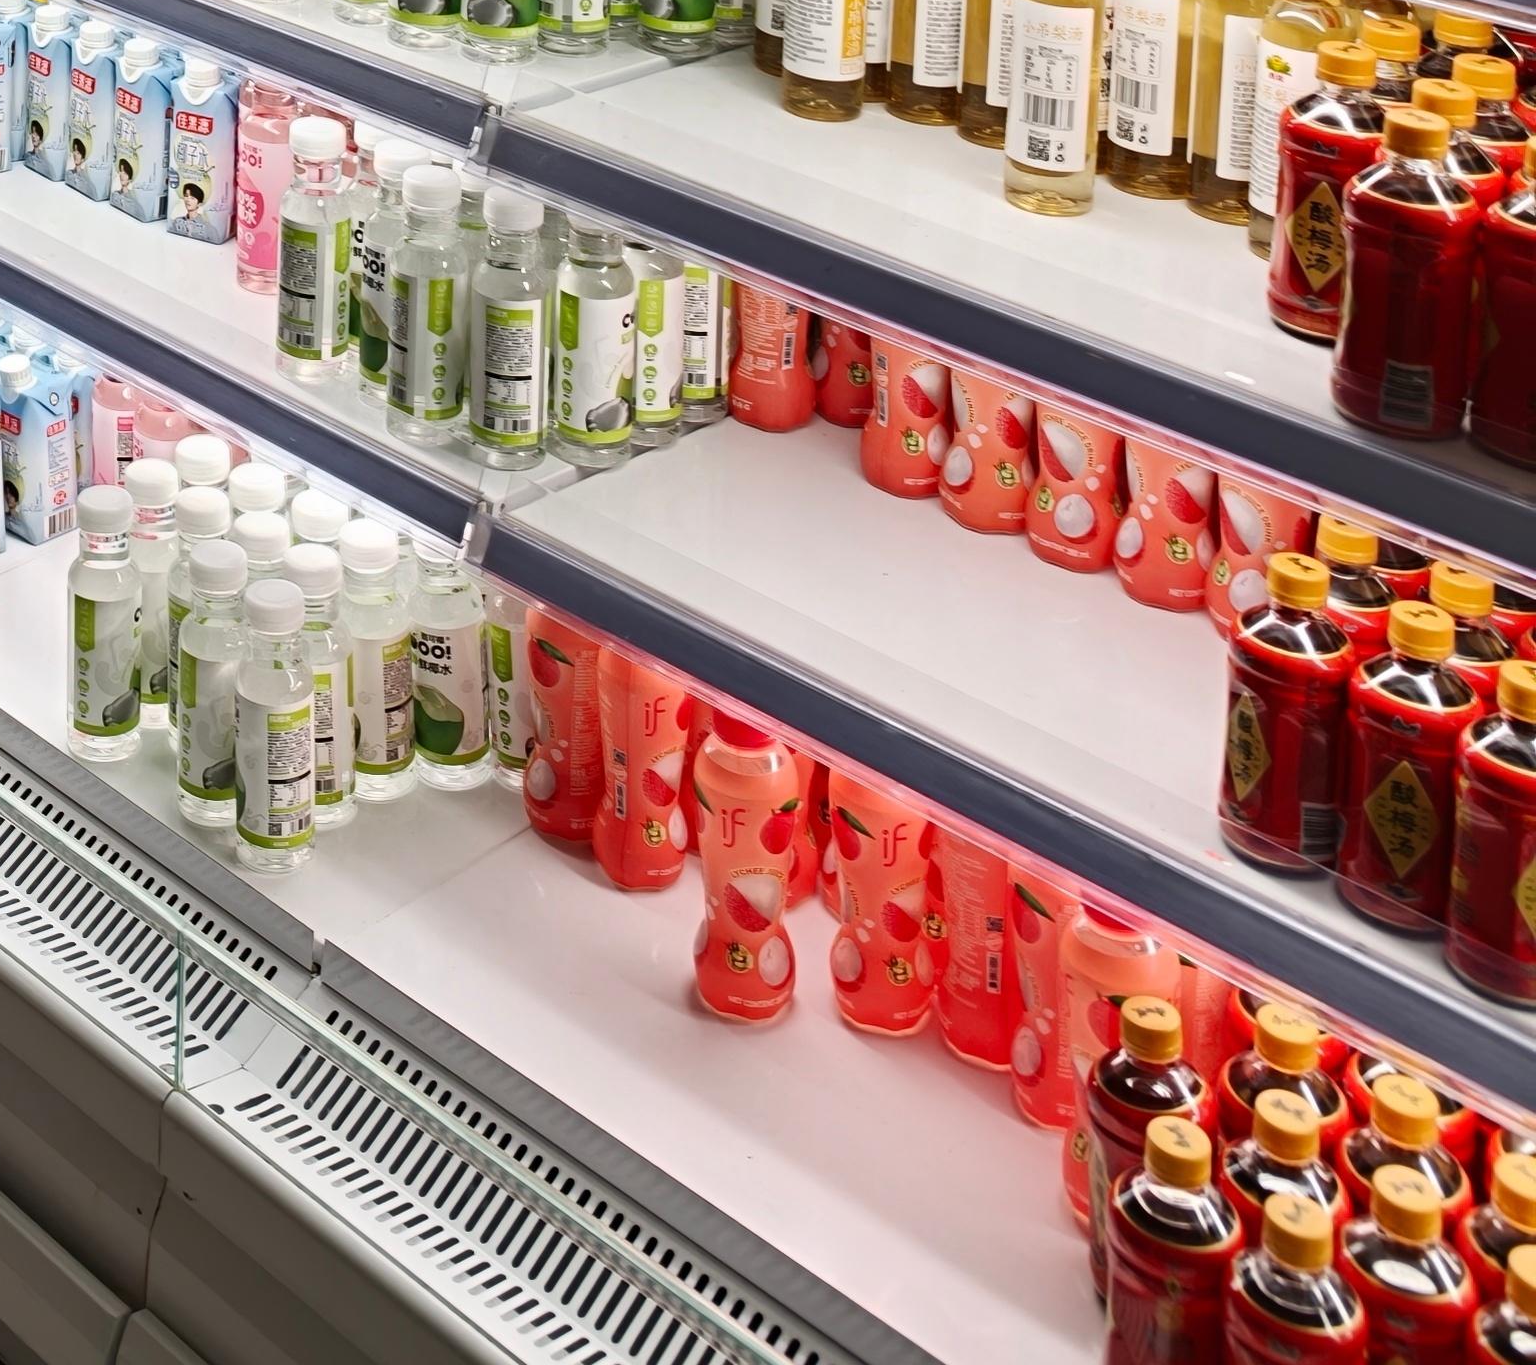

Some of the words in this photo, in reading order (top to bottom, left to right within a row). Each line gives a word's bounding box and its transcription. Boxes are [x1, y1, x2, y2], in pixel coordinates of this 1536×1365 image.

[1023, 20, 1083, 41] 小吊梨汤
[1306, 199, 1337, 275] 酸梅汤
[644, 696, 666, 737] if
[721, 809, 747, 848] if
[1387, 777, 1422, 861] 酸梅汤
[883, 823, 909, 867] if
[730, 867, 762, 878] LYCHEE
